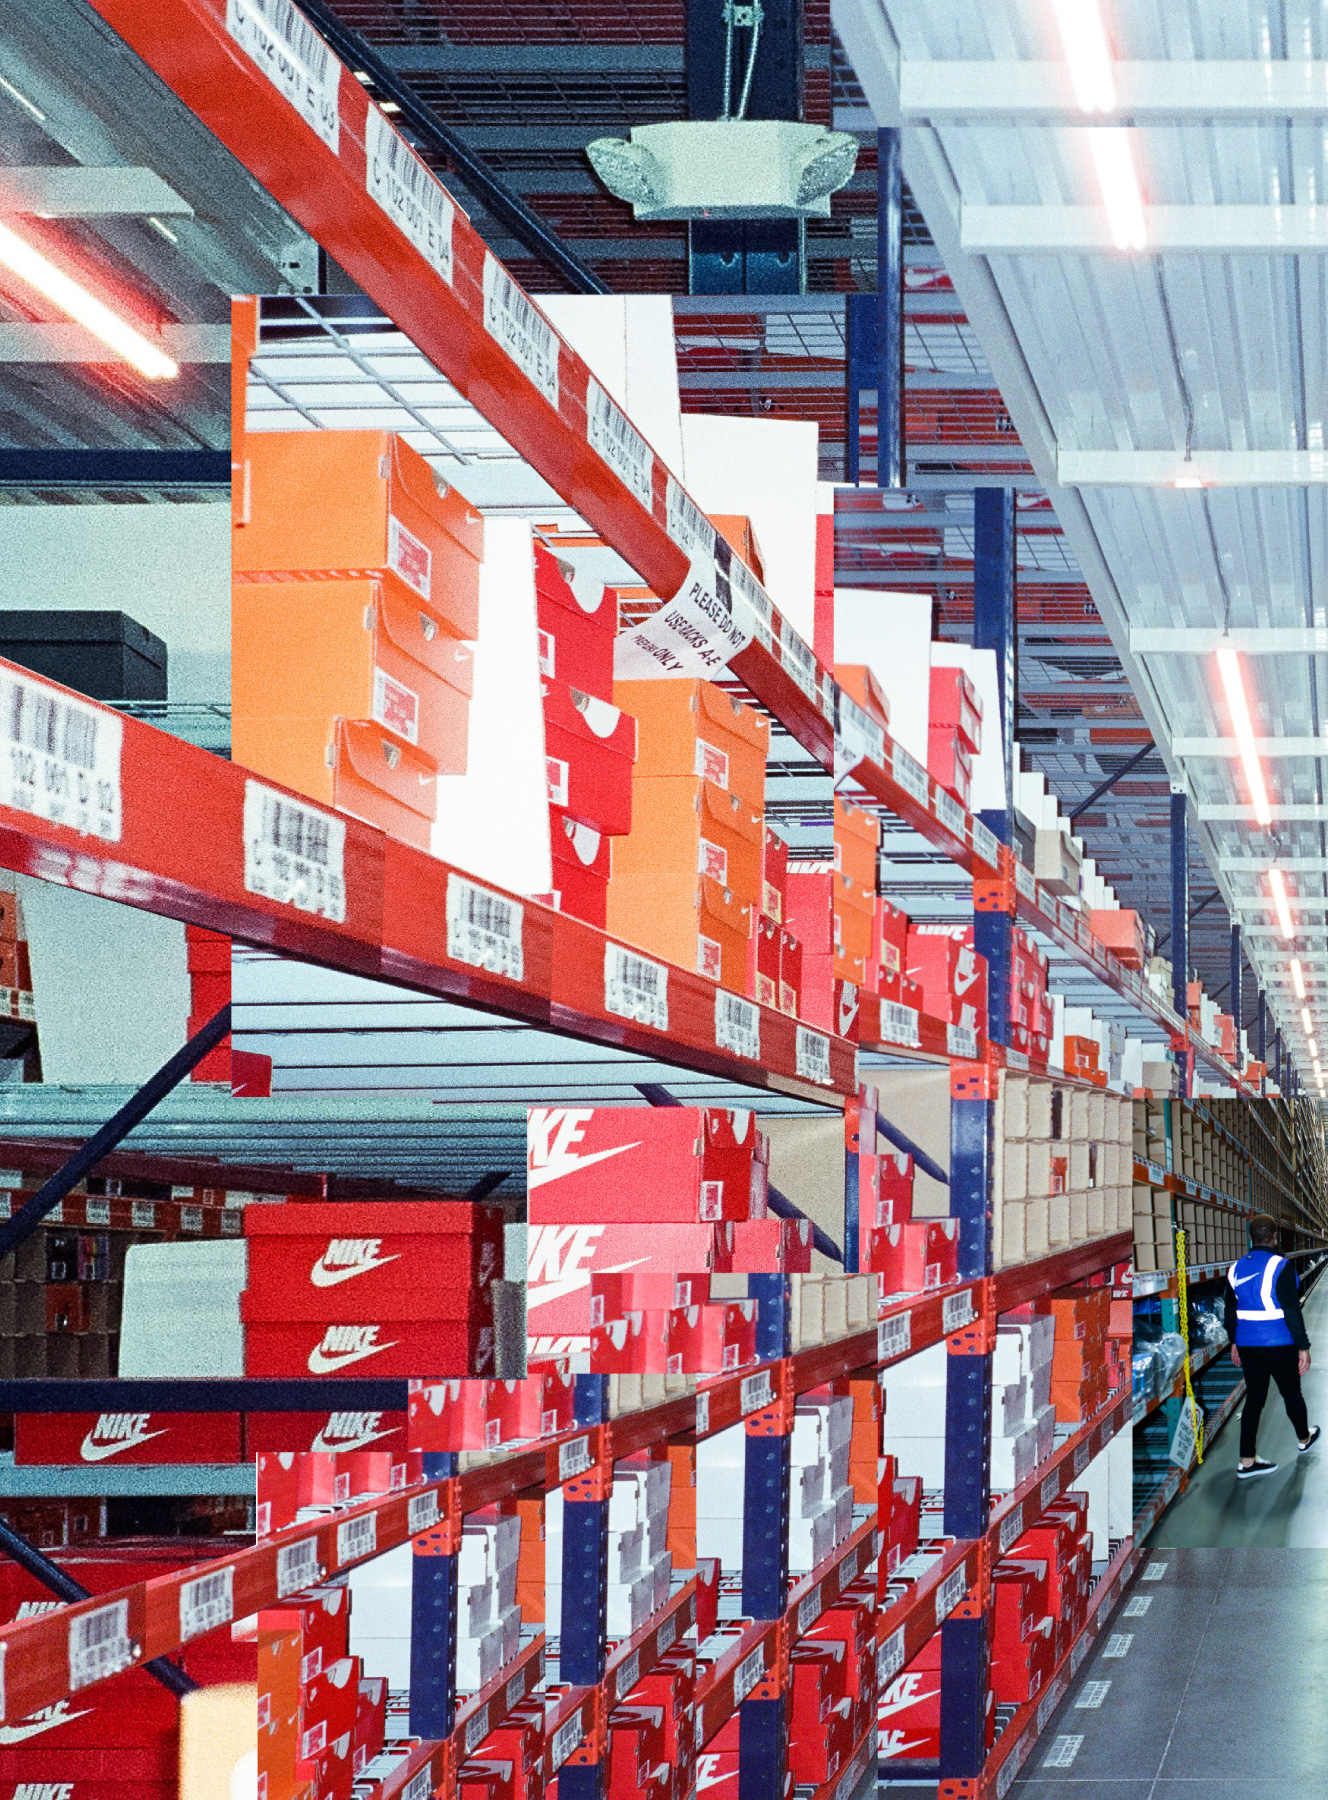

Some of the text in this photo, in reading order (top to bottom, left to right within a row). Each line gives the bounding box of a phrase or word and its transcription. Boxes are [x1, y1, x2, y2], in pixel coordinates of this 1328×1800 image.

[689, 582, 747, 649] PLEASE DO NOT
[664, 609, 683, 631] USE
[698, 648, 722, 667] A-E
[653, 648, 685, 671] ONLY
[323, 1239, 382, 1265] NIKE
[321, 1326, 381, 1352] NIKE
[94, 1413, 151, 1439] NIKE
[323, 1412, 382, 1438] NIKE
